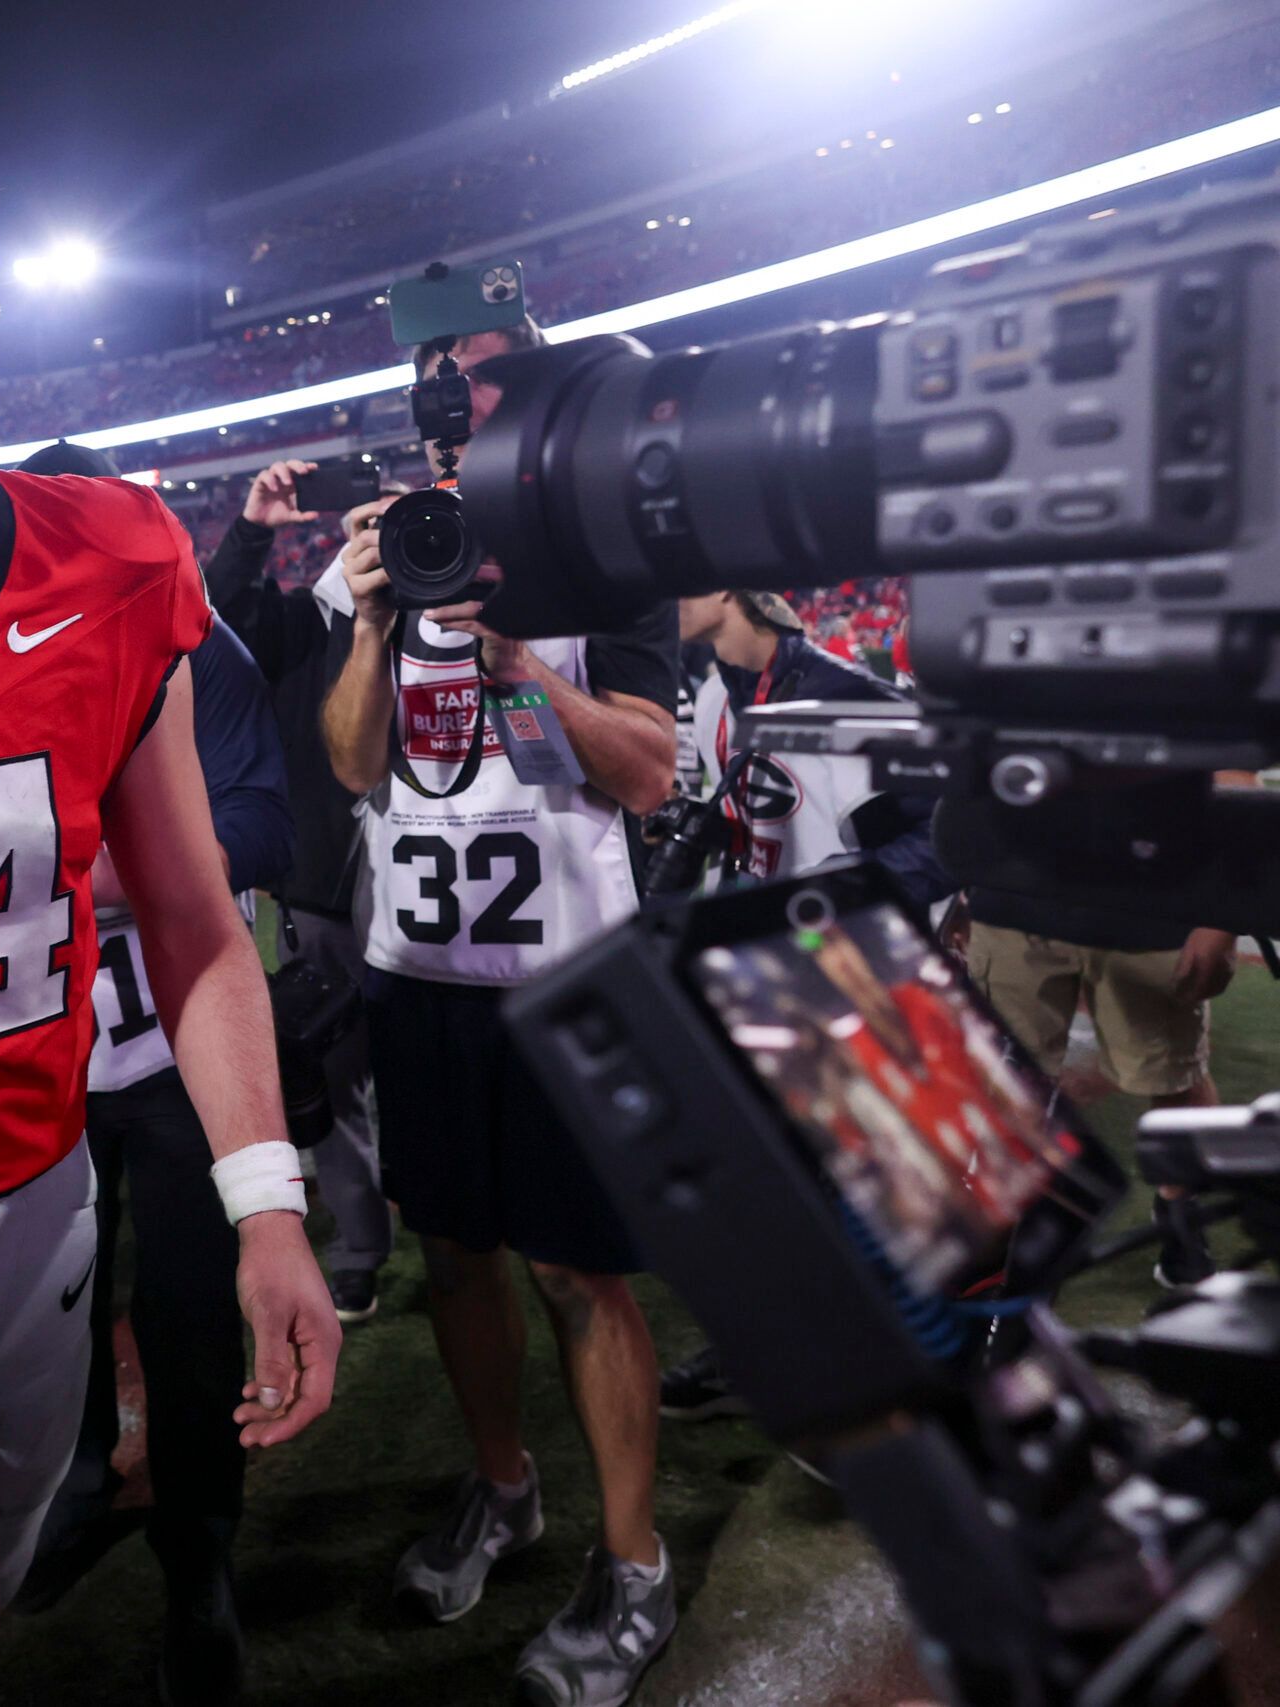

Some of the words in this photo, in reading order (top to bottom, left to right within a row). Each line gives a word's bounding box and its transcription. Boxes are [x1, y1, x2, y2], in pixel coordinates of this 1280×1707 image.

[435, 687, 480, 712] FAR
[412, 709, 492, 732] BURE
[430, 733, 500, 751] INSURCE
[392, 832, 543, 945] 32
